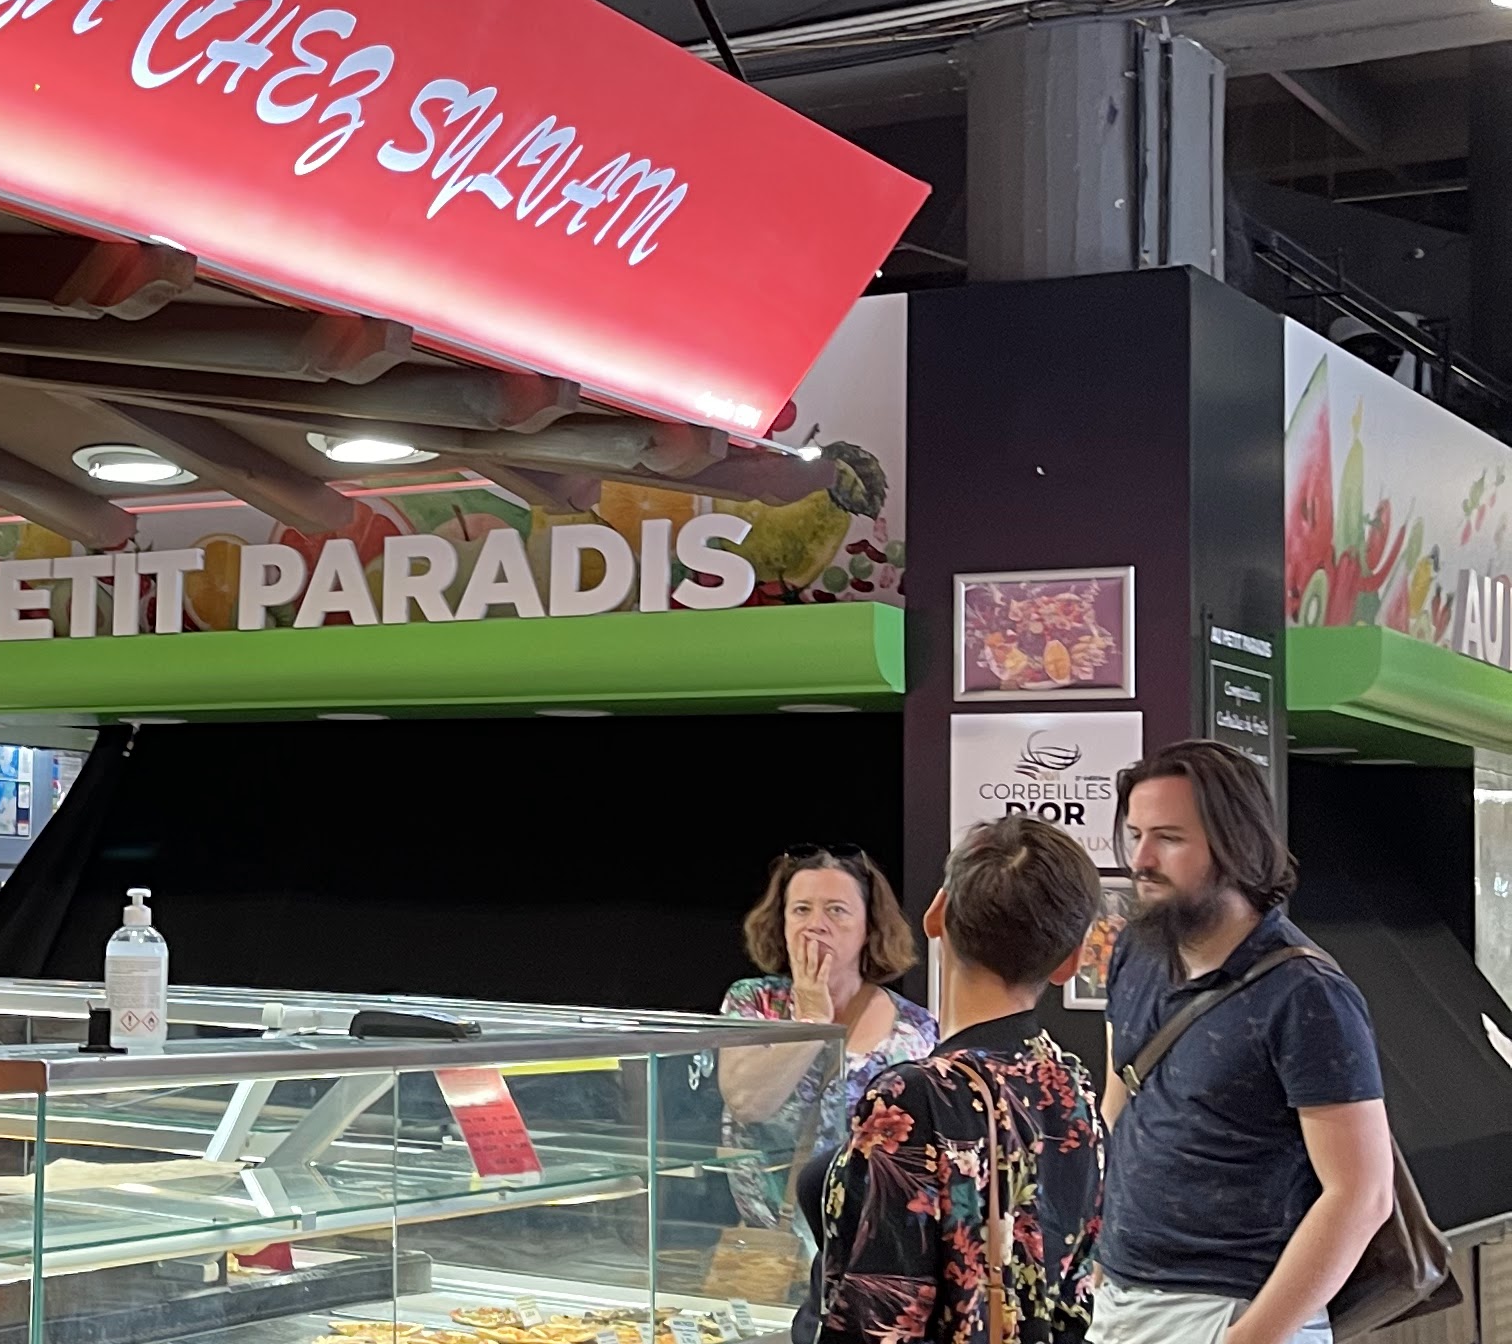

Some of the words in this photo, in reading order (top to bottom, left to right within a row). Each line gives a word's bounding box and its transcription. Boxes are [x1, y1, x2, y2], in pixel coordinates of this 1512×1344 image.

[238, 512, 755, 632] PARADIS
[979, 783, 1112, 800] CORBEILLES
[1005, 802, 1085, 825] D'OR
